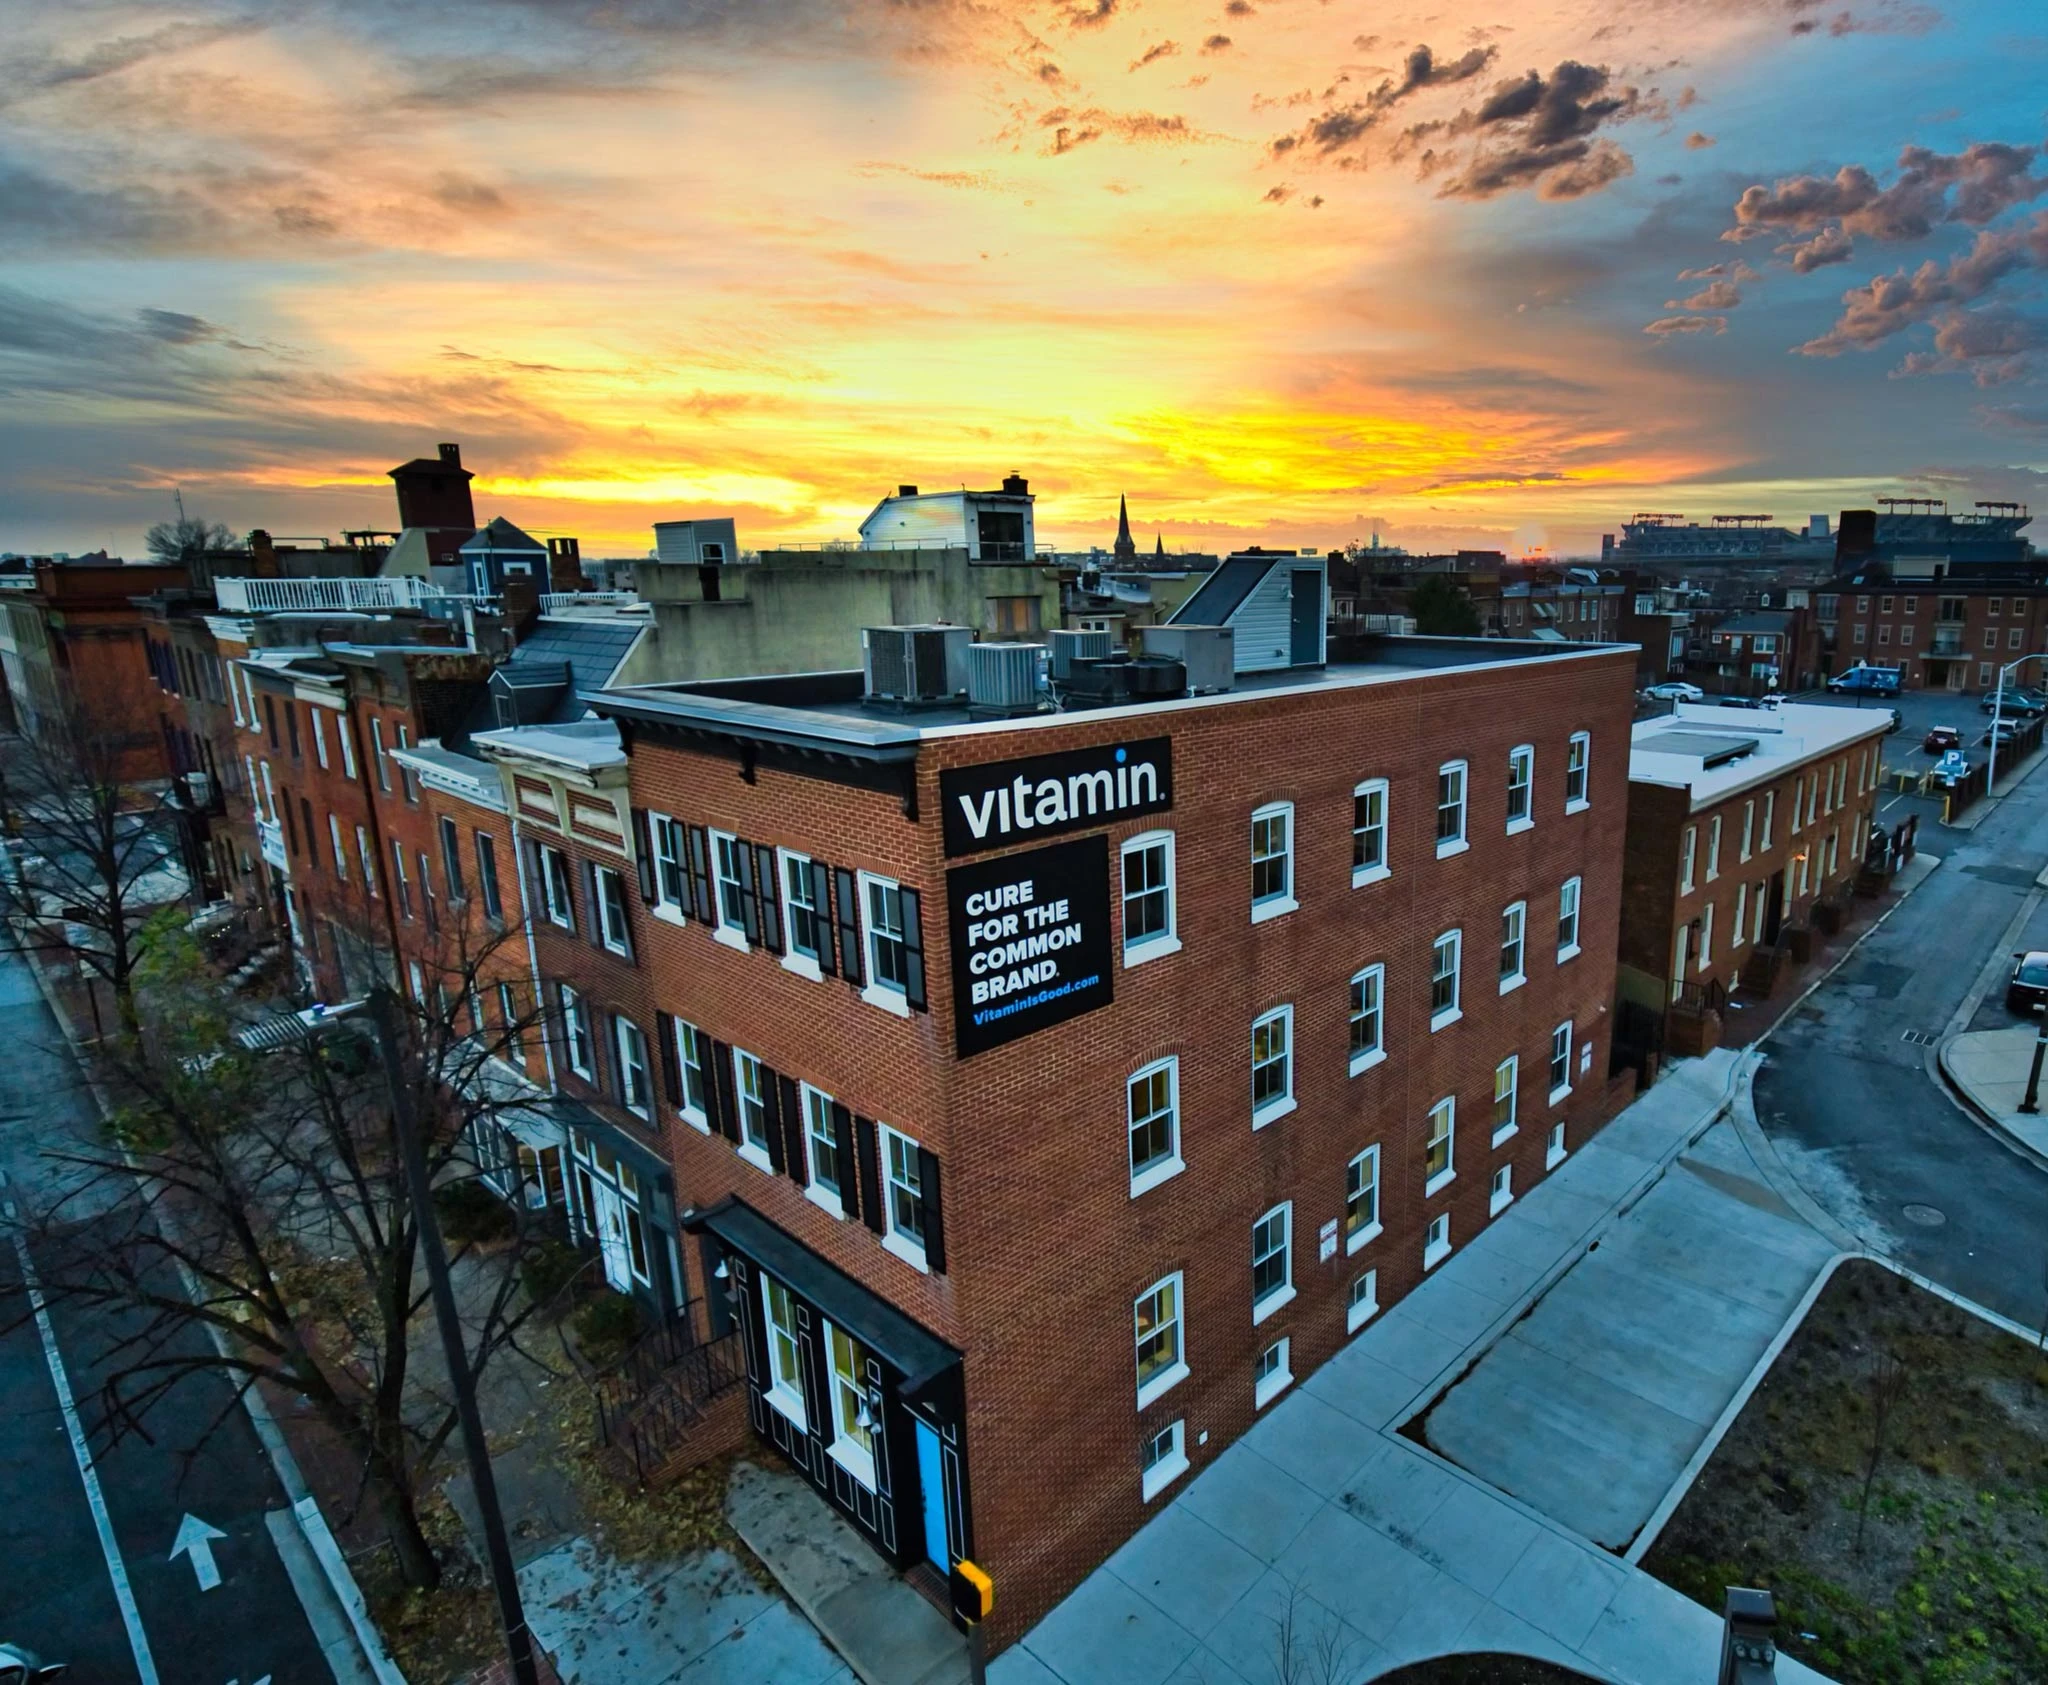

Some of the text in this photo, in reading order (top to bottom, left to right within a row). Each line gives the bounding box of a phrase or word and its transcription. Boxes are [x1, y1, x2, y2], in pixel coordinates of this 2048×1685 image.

[1947, 751, 1960, 765] P
[966, 879, 1034, 917] CURE
[967, 898, 1070, 947] FOR THE
[969, 922, 1082, 975] COMMON
